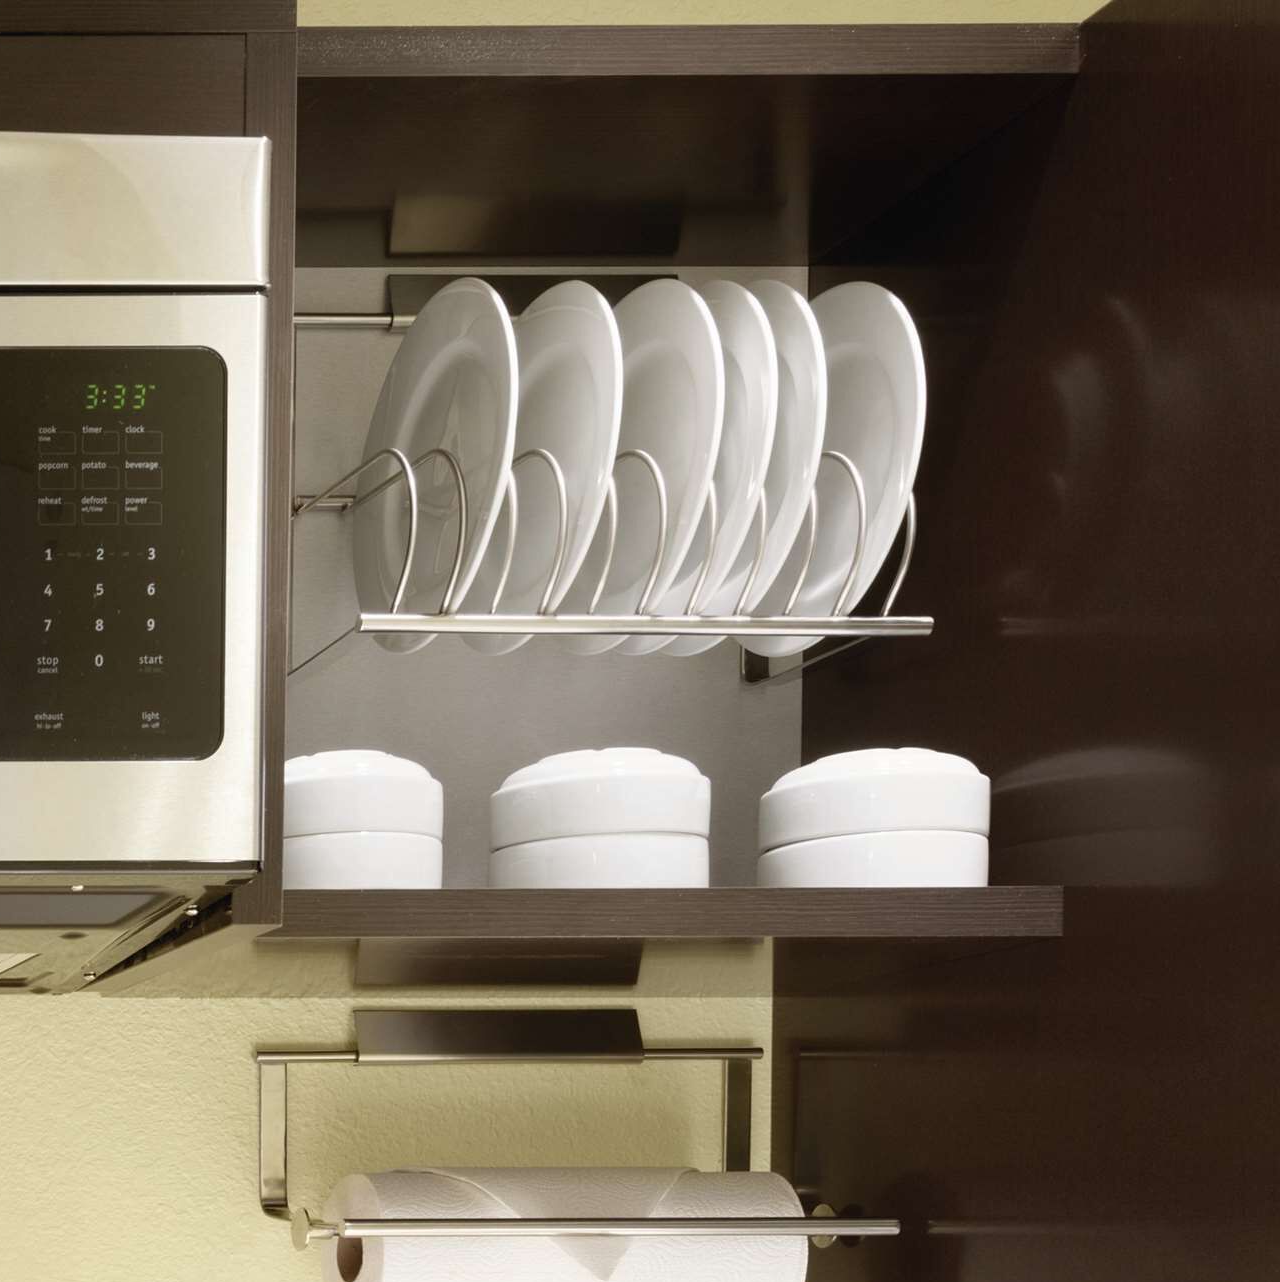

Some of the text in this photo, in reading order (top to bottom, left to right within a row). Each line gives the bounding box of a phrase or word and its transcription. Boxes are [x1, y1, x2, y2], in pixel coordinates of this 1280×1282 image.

[86, 384, 146, 409] 3:33
[38, 426, 57, 434] cook
[82, 425, 103, 434] timer
[125, 425, 145, 433] clock
[38, 462, 69, 471] popcorn
[81, 461, 107, 470] potato
[125, 461, 159, 470] beverage
[38, 496, 62, 504] reheat
[81, 496, 108, 504] defrost
[125, 497, 148, 505] power
[44, 548, 52, 560] 1
[96, 548, 104, 560] 2
[147, 547, 156, 560] 3
[44, 584, 52, 597] 4
[96, 583, 104, 596] 5
[147, 583, 155, 596] 6
[44, 619, 52, 632] 7
[95, 619, 104, 632] 8
[147, 618, 155, 631] 9
[37, 656, 59, 666] stop
[95, 654, 104, 667] 0
[139, 655, 163, 664] start
[34, 712, 64, 720] exhaust
[141, 711, 160, 721] light
